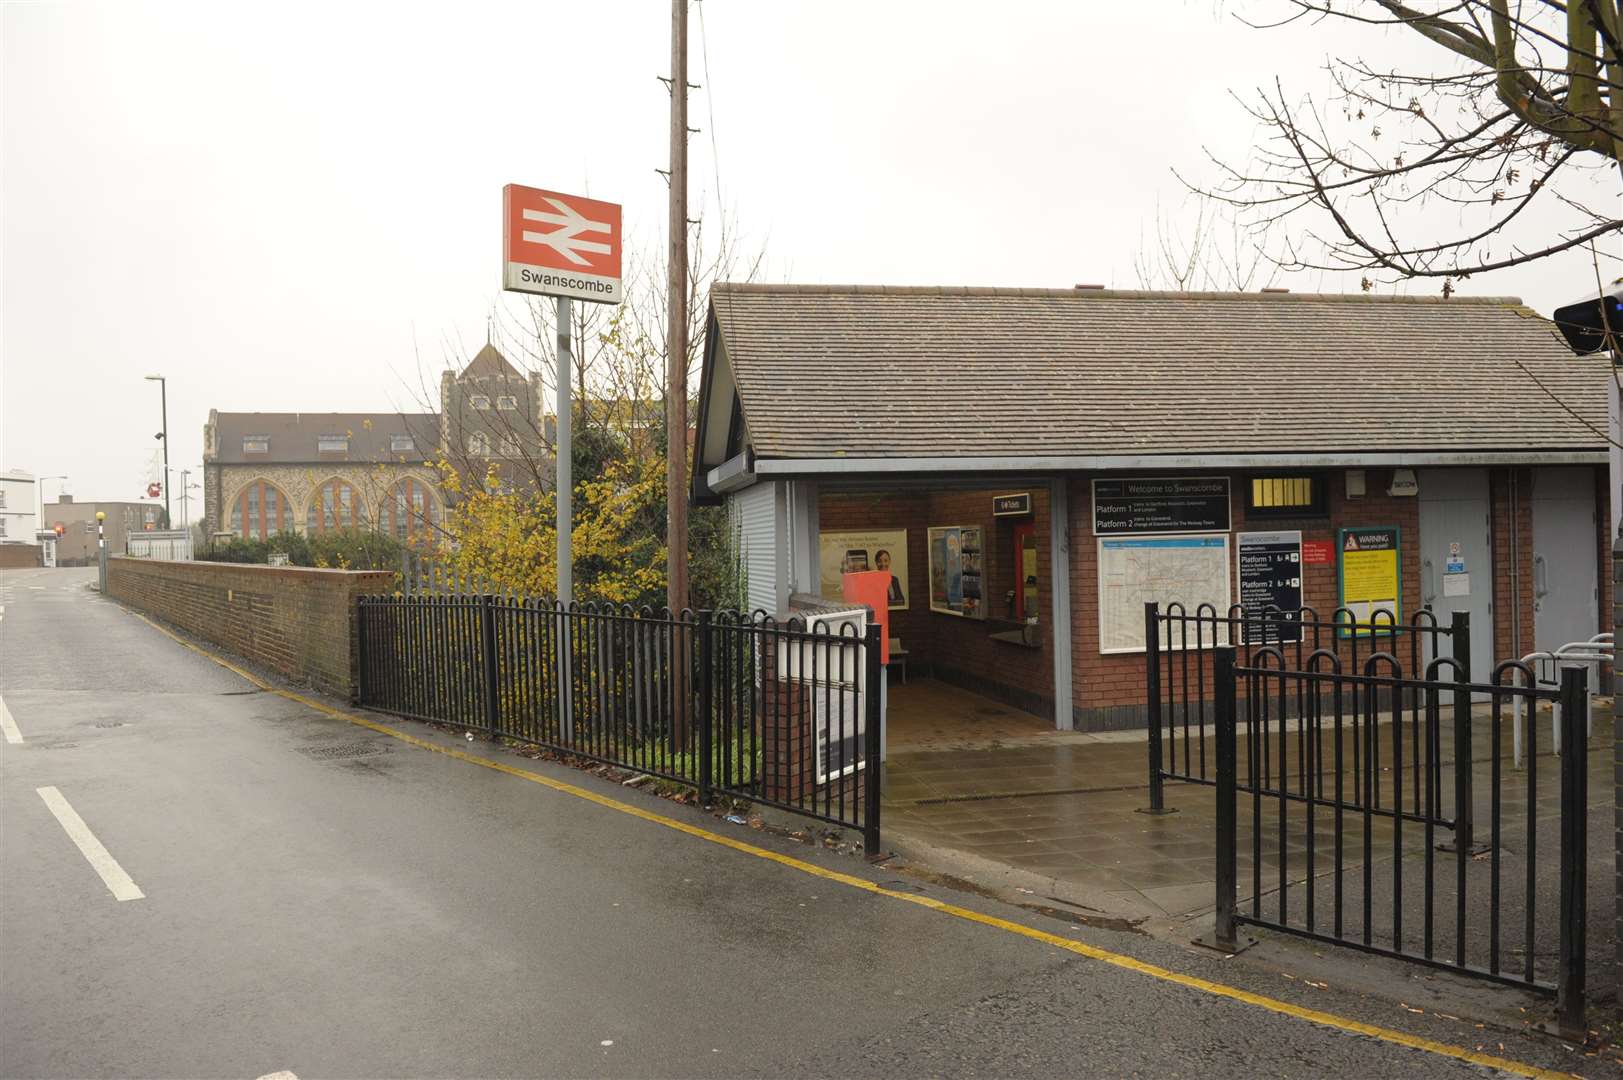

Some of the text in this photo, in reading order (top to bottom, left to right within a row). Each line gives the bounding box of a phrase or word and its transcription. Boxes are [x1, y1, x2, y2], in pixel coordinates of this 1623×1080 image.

[521, 269, 613, 293] Swanscombe
[1128, 484, 1163, 493] Welcome
[1165, 485, 1174, 493] to
[1174, 483, 1223, 492] Swanscombe
[1097, 504, 1126, 513] Platform
[1128, 504, 1132, 513] 1
[1097, 519, 1133, 529] Platform 2
[1359, 534, 1389, 544] WARNING
[1241, 554, 1272, 563] Platform 1
[1242, 580, 1273, 589] Platform 2
